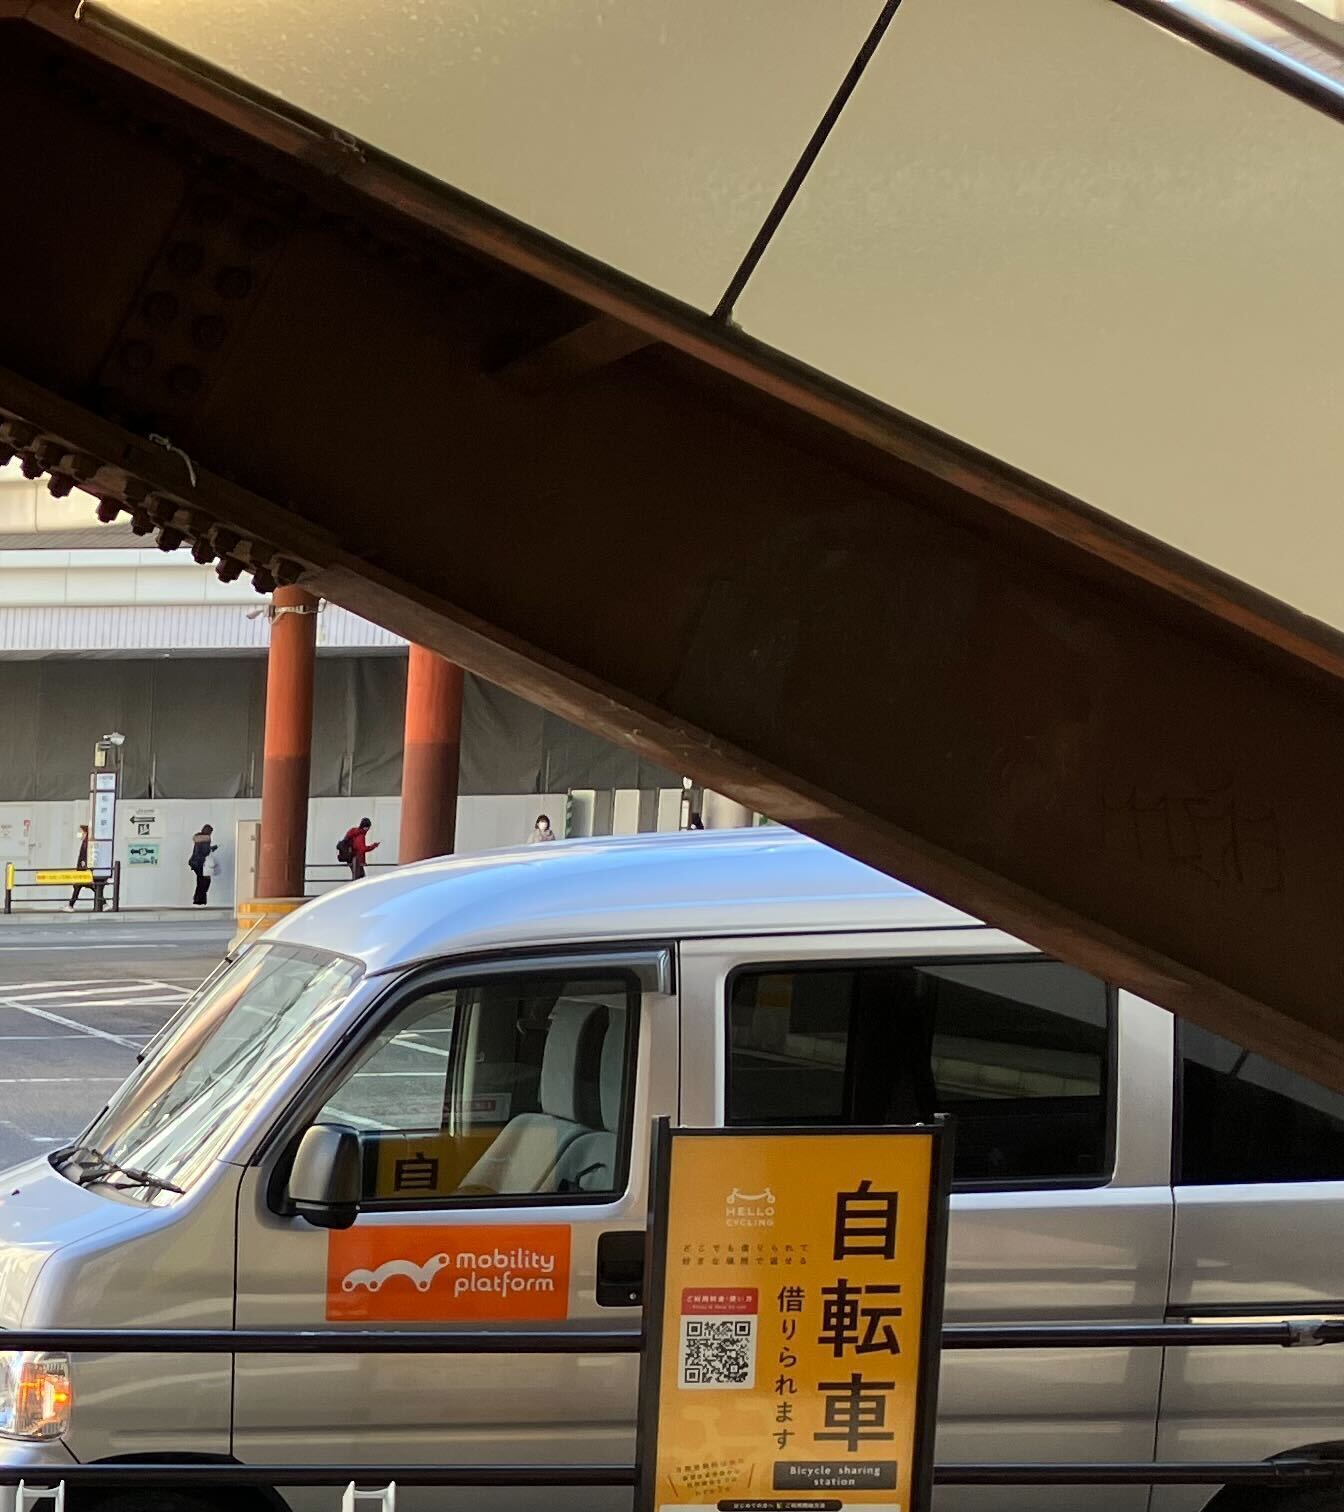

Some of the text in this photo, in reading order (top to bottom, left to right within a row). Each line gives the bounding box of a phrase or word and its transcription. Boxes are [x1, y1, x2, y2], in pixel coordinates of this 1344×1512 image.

[726, 1207, 775, 1217] HELLO
[726, 1218, 774, 1227] CYCLING
[455, 1248, 555, 1272] mobility
[454, 1271, 555, 1298] platform
[813, 1180, 902, 1452] 自転車
[773, 1286, 806, 1450] 借りられます
[790, 1465, 881, 1478] Bicycle sharing
[813, 1477, 856, 1486] station
